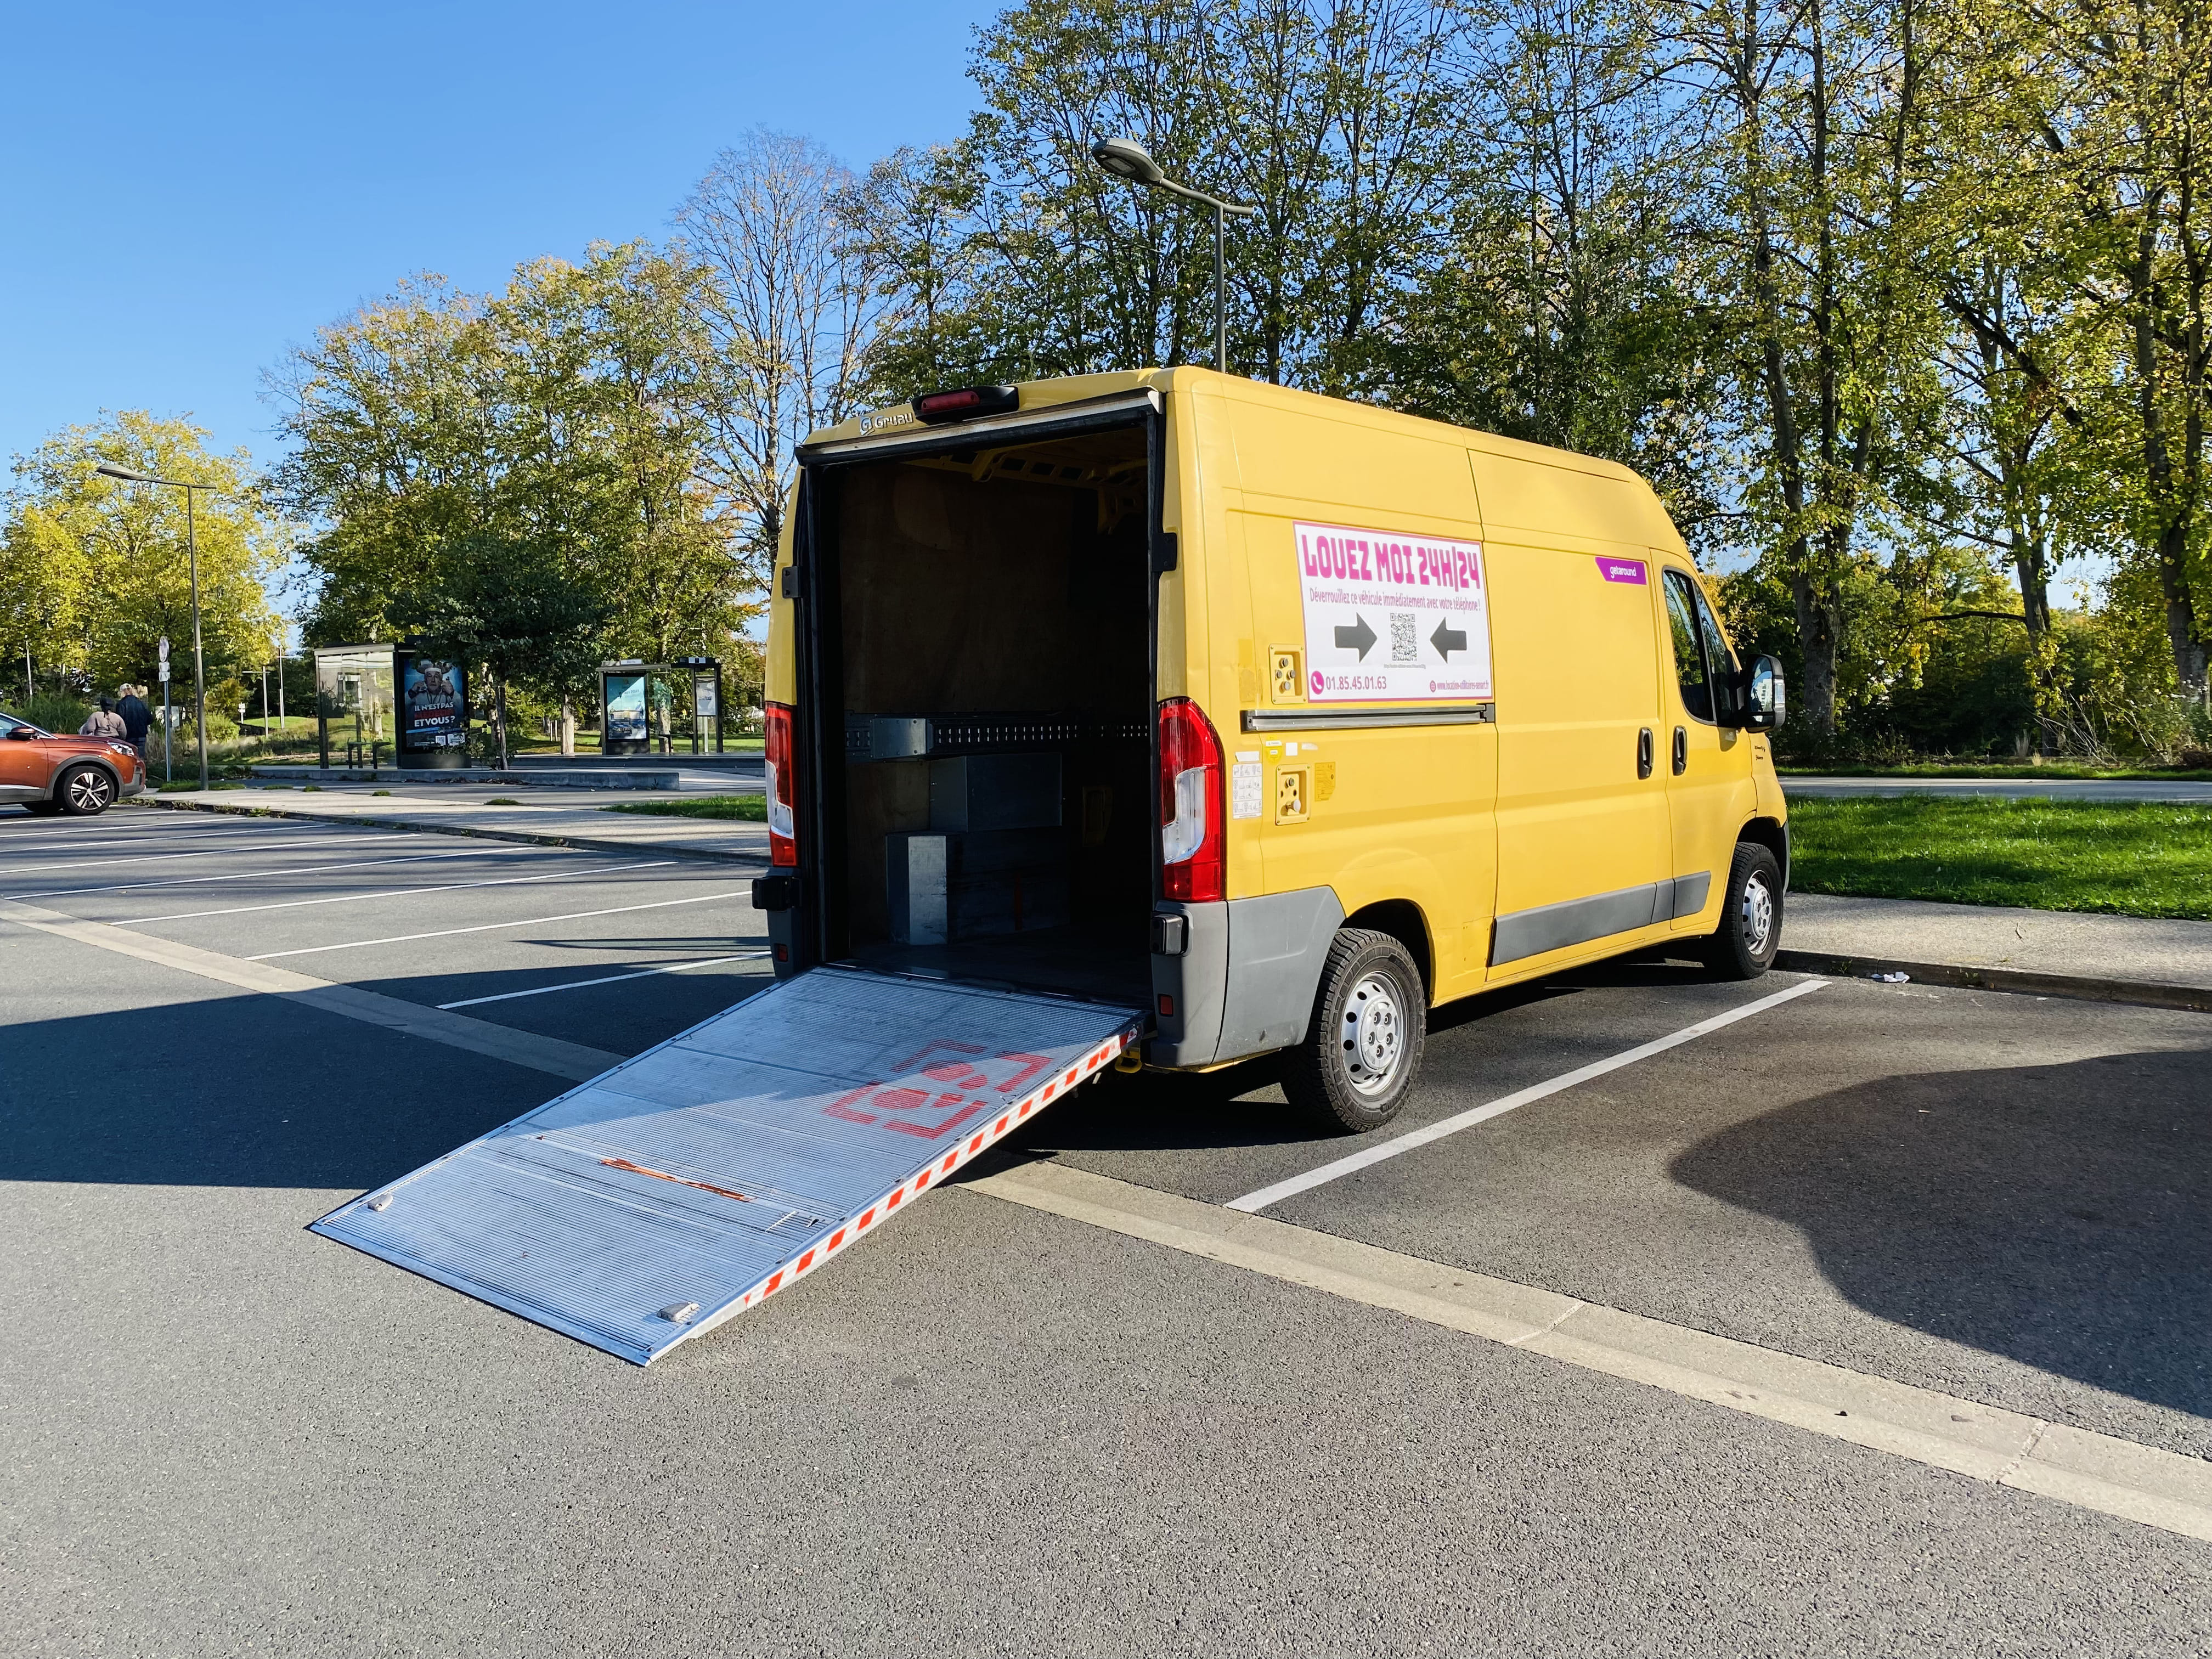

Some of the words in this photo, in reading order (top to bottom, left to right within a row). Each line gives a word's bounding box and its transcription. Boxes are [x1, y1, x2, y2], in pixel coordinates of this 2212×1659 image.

[874, 412, 913, 429] Gruau
[1302, 534, 1372, 581] LOUEZ
[1374, 541, 1415, 584] MOI
[1610, 566, 1637, 579] getaround
[1310, 586, 1350, 604] Déverrouillez
[1351, 592, 1358, 605] ce
[1358, 590, 1383, 606] véhicule
[1383, 592, 1426, 608] immédiatement
[1426, 598, 1439, 609] avec
[1439, 597, 1453, 610] votre
[1453, 596, 1478, 615] téléphone
[1325, 675, 1387, 691] 01.85.45.01.63
[414, 719, 425, 727] ET
[424, 716, 450, 726] VOUS
